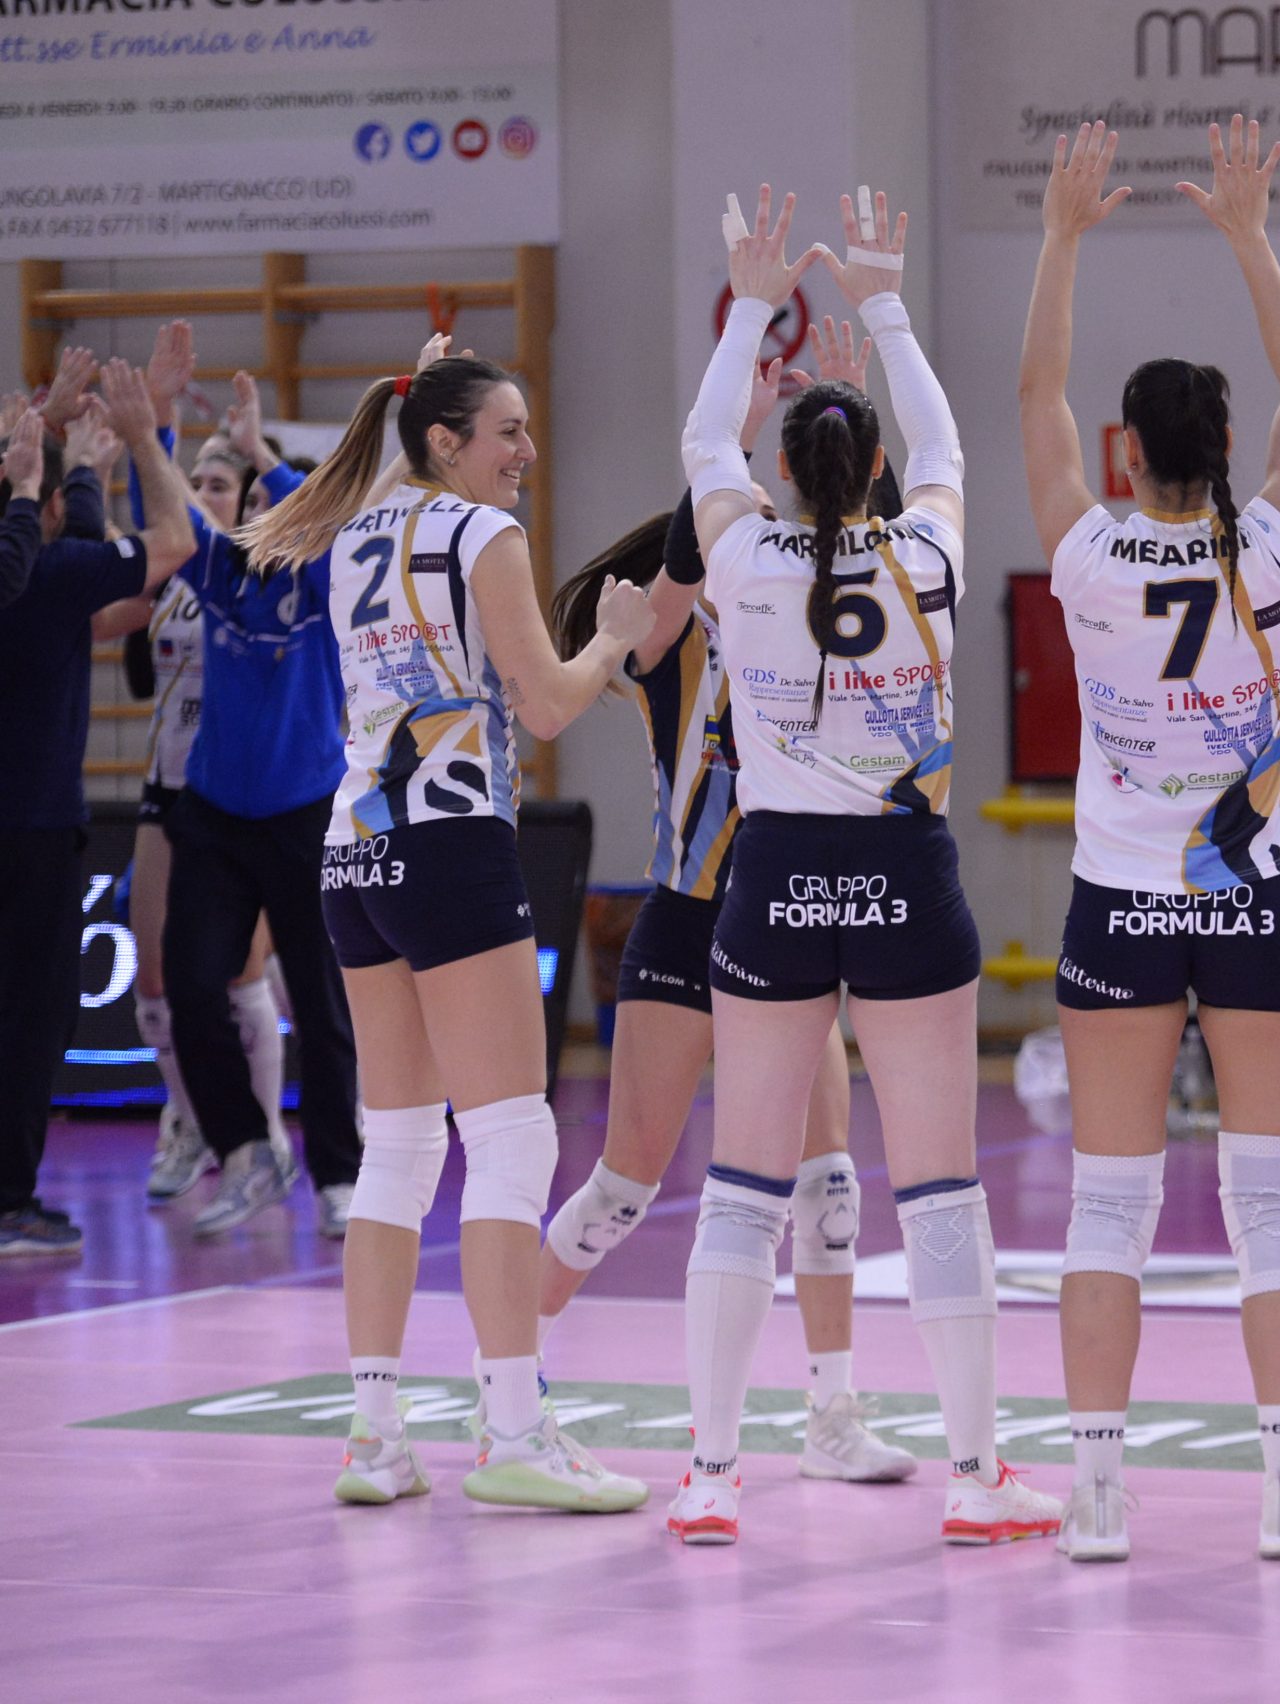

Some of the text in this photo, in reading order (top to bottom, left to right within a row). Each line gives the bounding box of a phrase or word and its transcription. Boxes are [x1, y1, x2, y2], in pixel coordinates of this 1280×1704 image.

[89, 29, 237, 60] Erminia
[243, 29, 267, 54] e
[271, 22, 376, 51] Anna
[158, 179, 306, 205] MARTIGNACCO
[309, 175, 354, 202] (UD)
[350, 534, 396, 631] 2
[806, 567, 889, 660] 6
[366, 630, 388, 651] like
[1142, 576, 1222, 682] 7
[743, 667, 816, 687] GDS De Salvo
[829, 671, 835, 690] i
[844, 671, 886, 690] like
[828, 694, 848, 702] Viale
[851, 693, 867, 702] San
[1084, 677, 1154, 708] GDS De Salvo
[1167, 693, 1174, 712] i
[1183, 691, 1225, 711] like
[1166, 714, 1186, 723] Viale
[1190, 714, 1206, 722] San
[1099, 729, 1156, 752] TRICENTER
[1207, 742, 1233, 750] IVECO
[850, 755, 906, 768] Gestam
[1187, 770, 1244, 784] Gestam
[320, 861, 405, 891] ORMULA 3
[789, 874, 887, 901] GRUPPO
[1132, 884, 1253, 909] GRUPPO
[769, 899, 908, 928] FORMULA 3
[1108, 909, 1275, 936] FORMULA 3
[1059, 956, 1136, 1000] datterino
